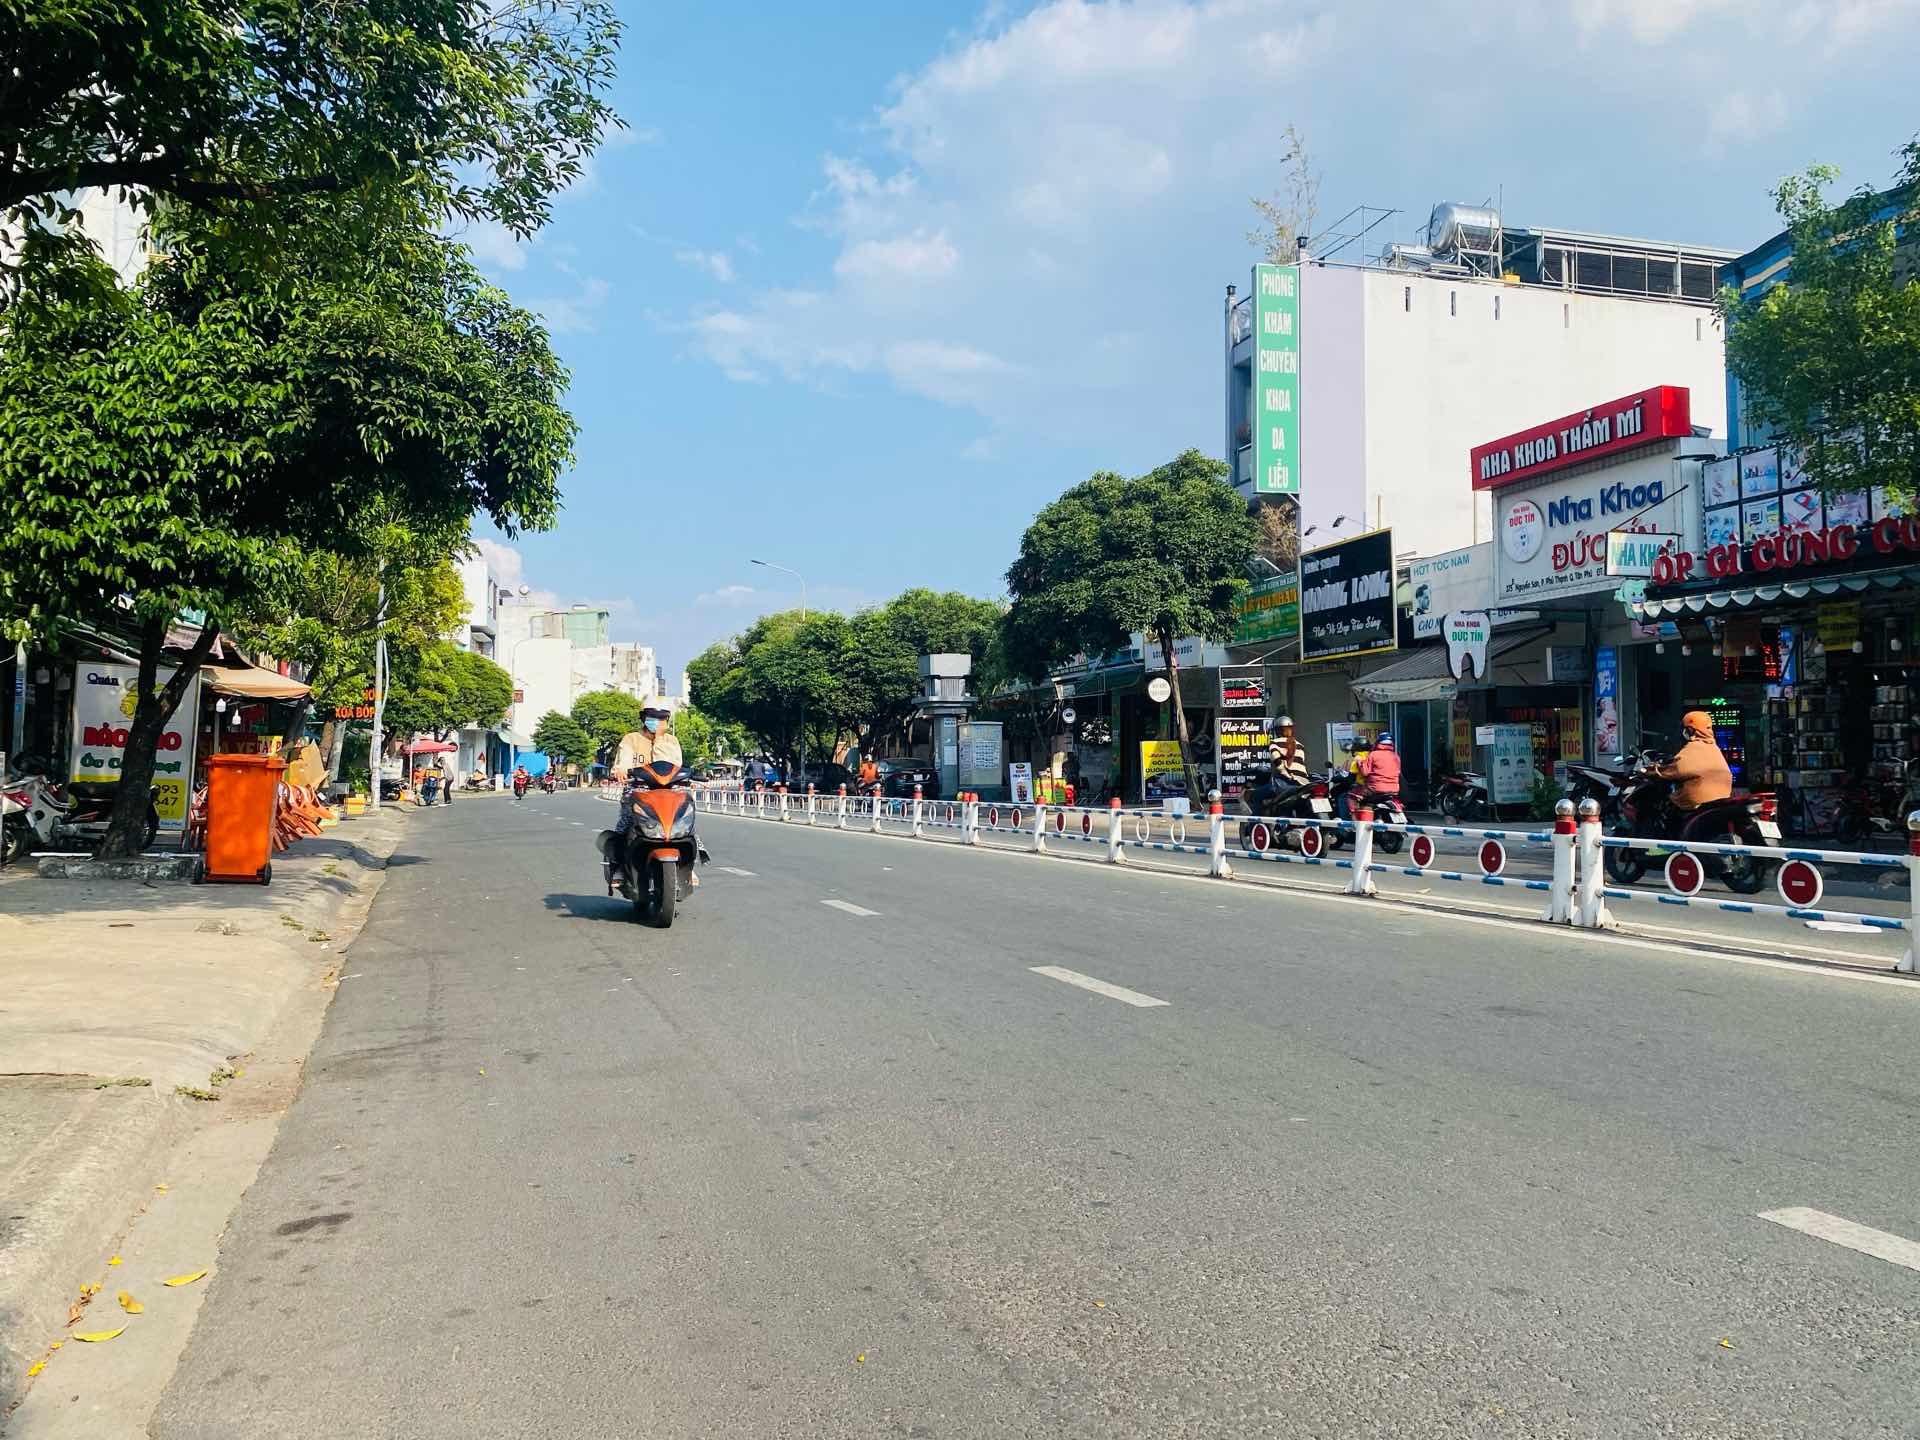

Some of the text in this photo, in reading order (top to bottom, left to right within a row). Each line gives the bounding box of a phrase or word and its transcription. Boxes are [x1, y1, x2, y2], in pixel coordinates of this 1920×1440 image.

[1262, 268, 1294, 297] PHÒNG
[1264, 307, 1292, 336] KHÁM
[1265, 388, 1291, 412] KHOA
[1272, 427, 1285, 450] DA
[1480, 449, 1511, 480] NHA
[1514, 434, 1557, 470] KHOA
[1559, 409, 1610, 454] THẨM
[1548, 496, 1593, 528] Nha
[1600, 479, 1664, 517] Khoa
[1451, 554, 1470, 568] NAM
[1552, 530, 1607, 572] ĐỨC
[1706, 533, 1743, 578] GÌ
[1752, 524, 1857, 572] CŨNG
[1470, 629, 1484, 642] TÍN
[1221, 732, 1249, 747] HOÀNG
